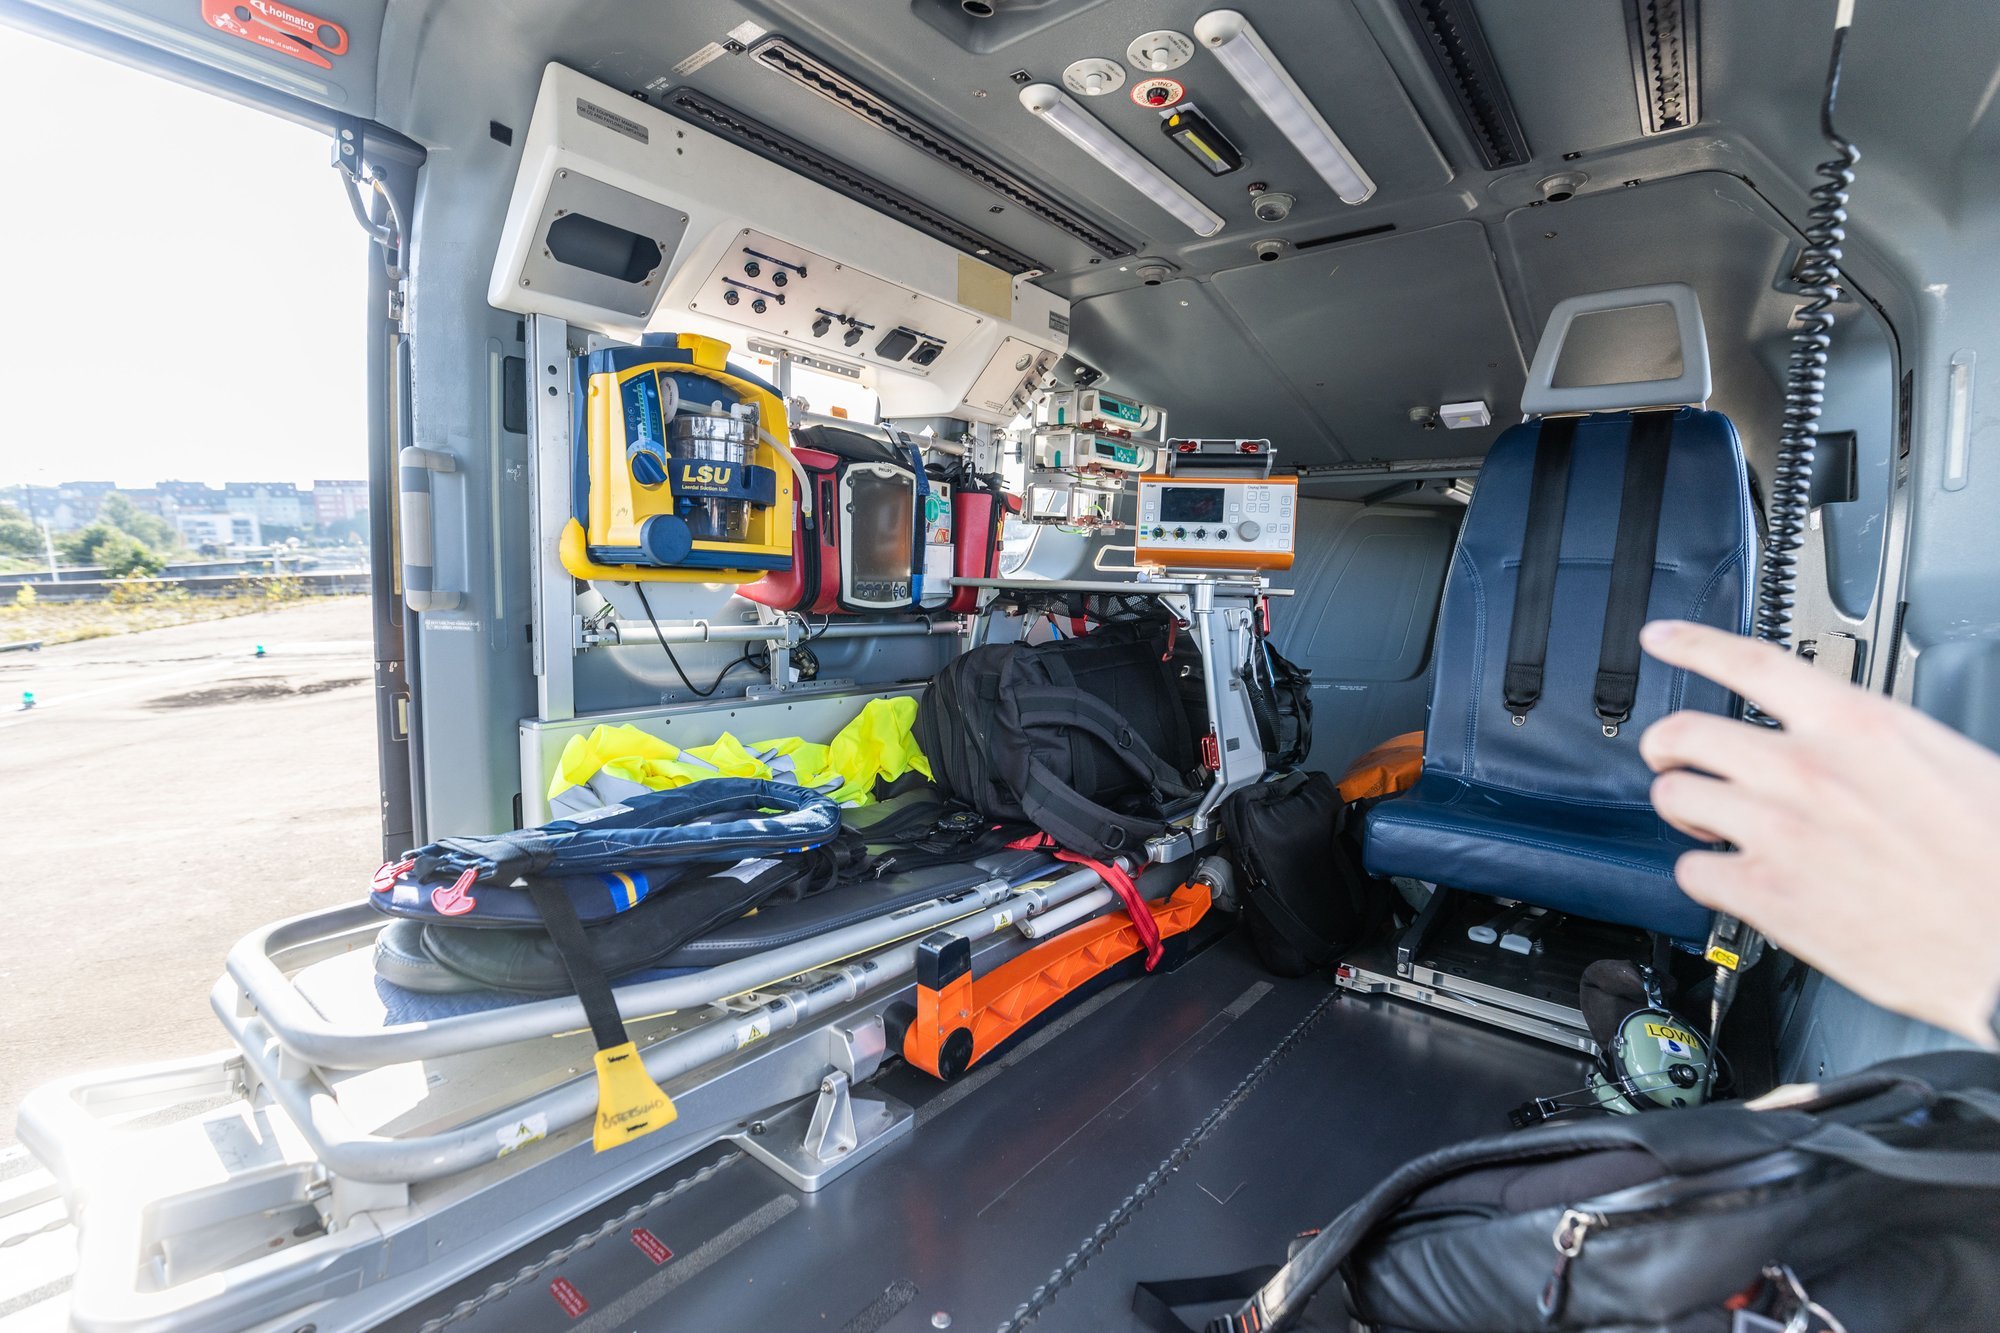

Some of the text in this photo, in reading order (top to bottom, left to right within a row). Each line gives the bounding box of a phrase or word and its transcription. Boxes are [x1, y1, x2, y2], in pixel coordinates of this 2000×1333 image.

[270, 4, 314, 30] holmatro
[682, 464, 731, 484] LSU
[878, 466, 892, 474] PHILIPS
